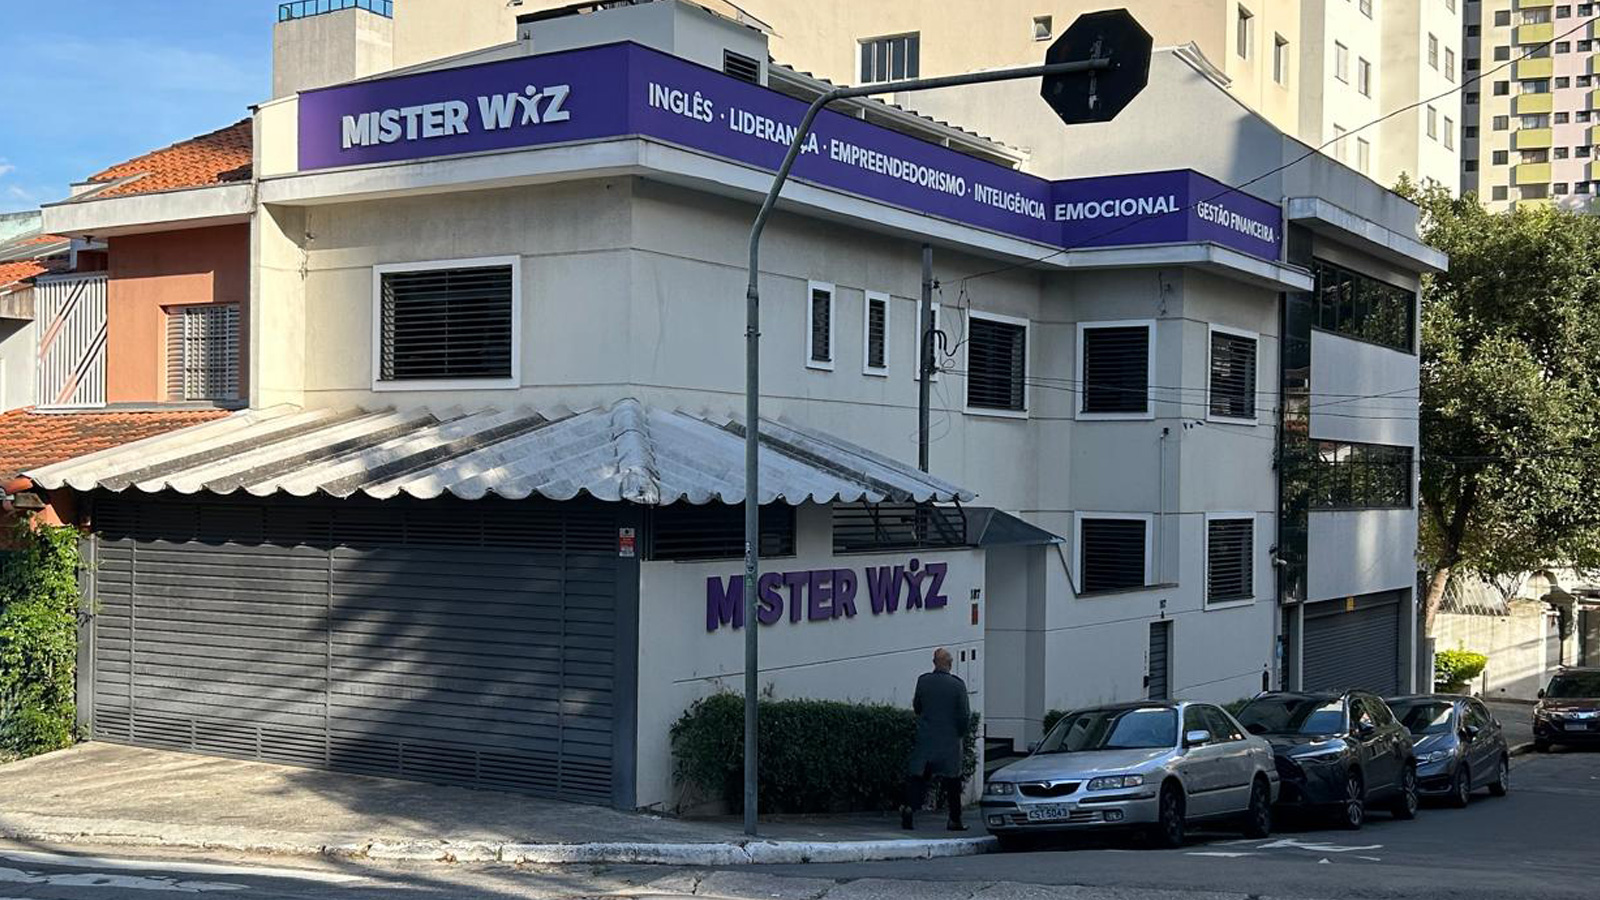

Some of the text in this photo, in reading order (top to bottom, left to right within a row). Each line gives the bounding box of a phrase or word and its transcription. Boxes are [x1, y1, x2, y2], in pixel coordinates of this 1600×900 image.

[342, 100, 469, 149] MISTER
[649, 82, 713, 123] INGLÊS
[830, 139, 966, 197] EMPREENDEDORISMO
[974, 183, 1046, 220] INTELIGÊNCIA
[1054, 195, 1180, 221] EMOCIONAL
[1197, 200, 1275, 244] GESTÃO FINANCEIRA
[706, 568, 858, 633] MSTER
